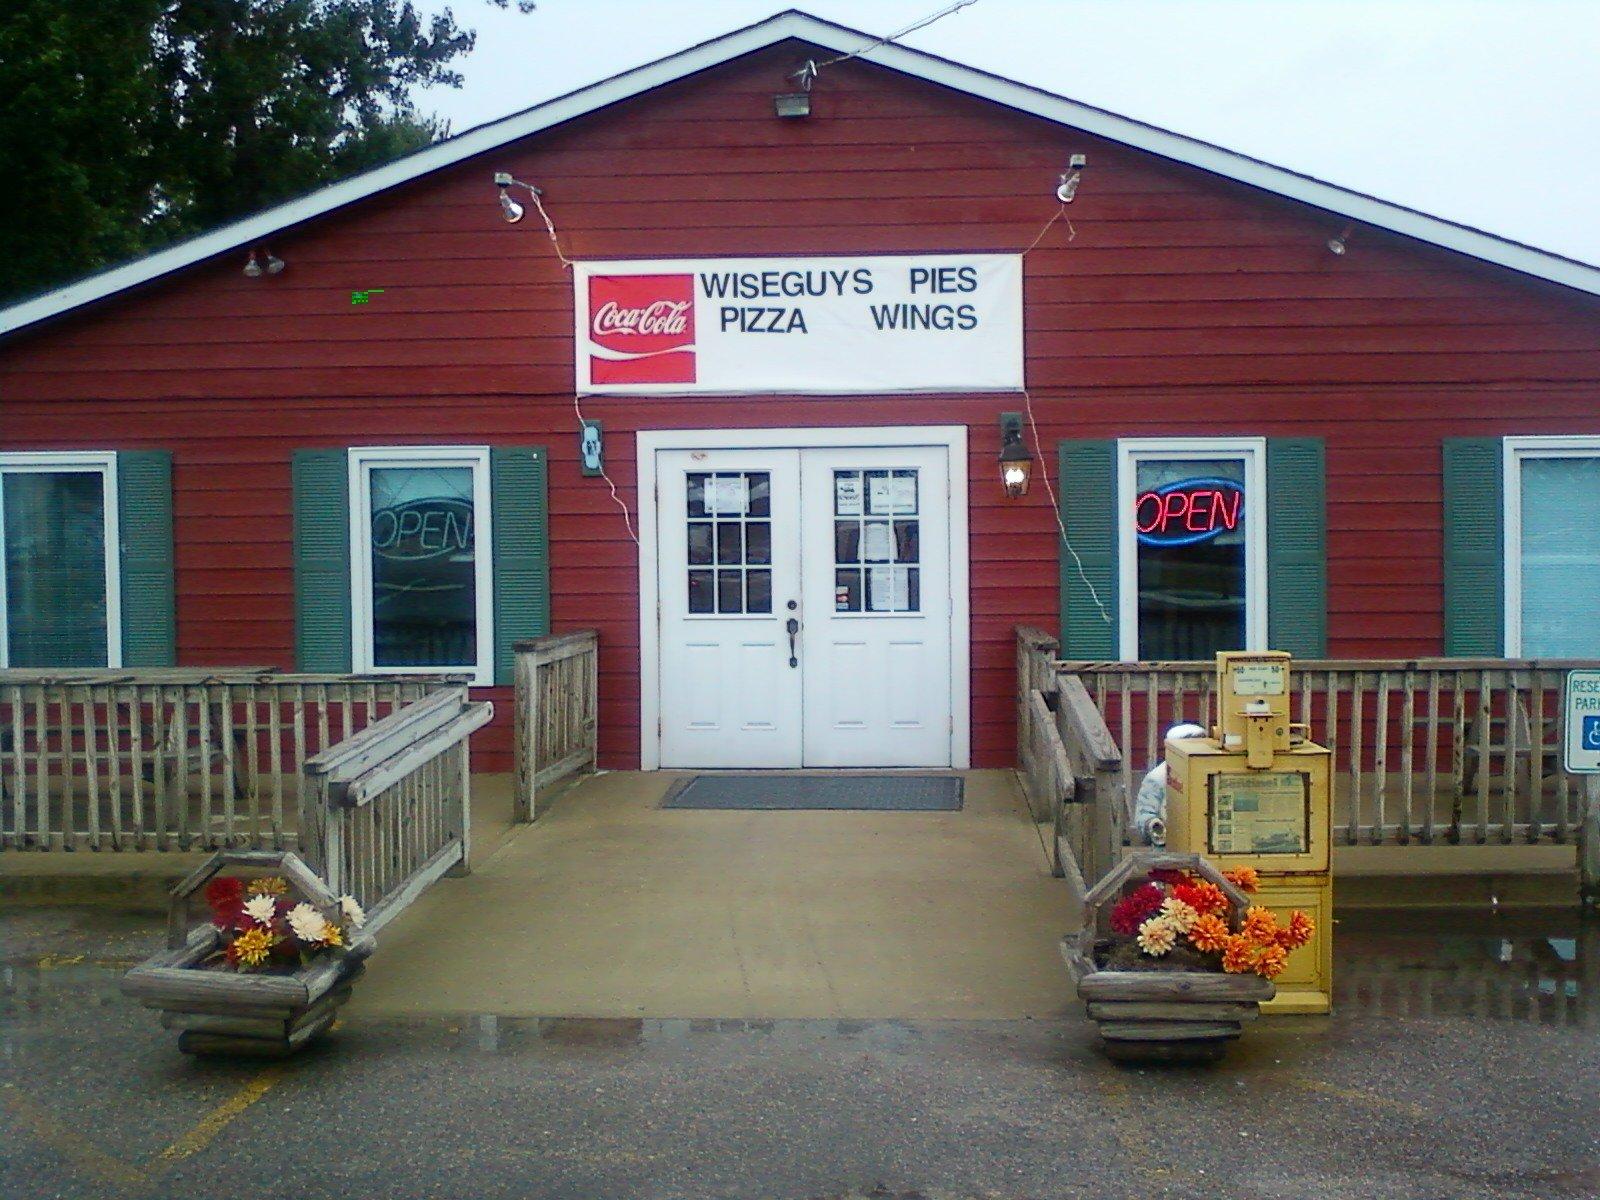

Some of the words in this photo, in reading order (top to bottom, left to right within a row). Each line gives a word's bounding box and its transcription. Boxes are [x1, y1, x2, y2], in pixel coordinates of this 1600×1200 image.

[700, 268, 873, 299] WISEGUYS
[910, 266, 978, 295] PIES
[593, 300, 693, 336] Coca-Cola
[720, 307, 808, 334] PIZZA
[871, 303, 978, 331] WINGS
[1135, 491, 1240, 533] OPEN
[372, 510, 472, 549] OPEN
[1576, 697, 1600, 710] PAR
